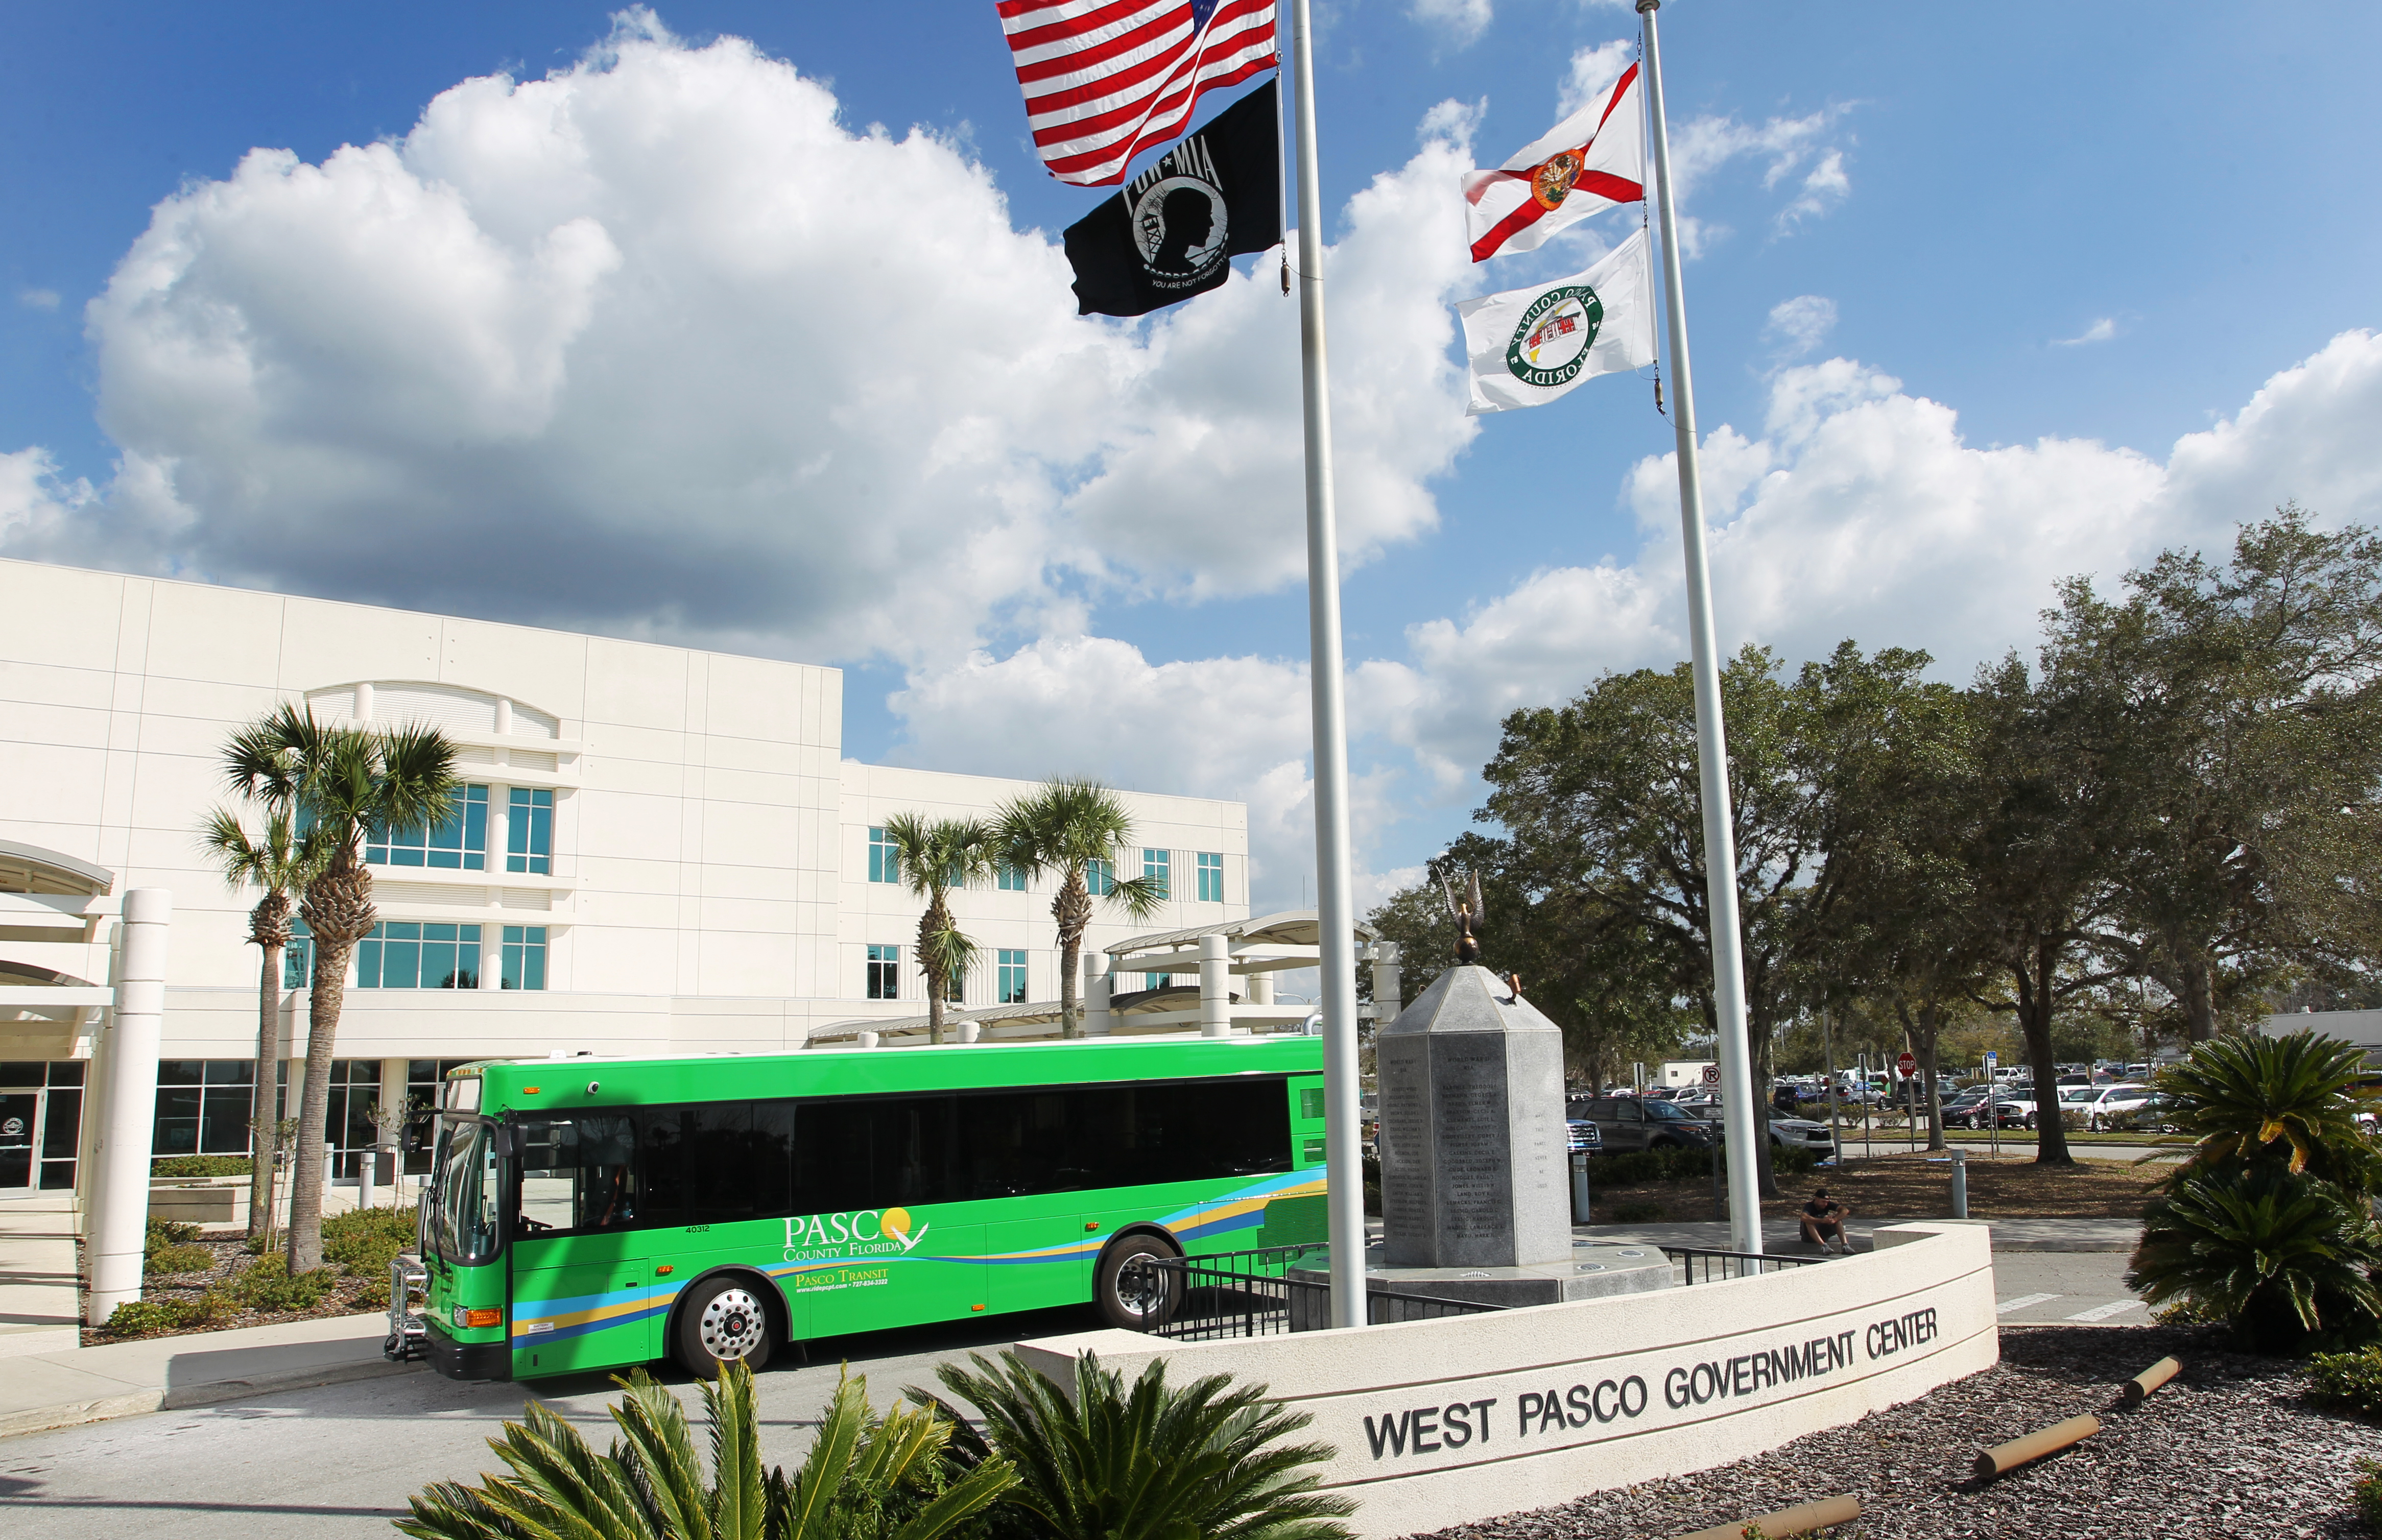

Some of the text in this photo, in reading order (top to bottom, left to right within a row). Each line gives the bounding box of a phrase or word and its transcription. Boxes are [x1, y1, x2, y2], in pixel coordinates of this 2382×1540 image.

[1173, 135, 1223, 192] MIA
[1152, 280, 1166, 288] YOU
[1182, 278, 1197, 287] NOT
[1899, 1060, 1915, 1070] STOP
[685, 1225, 710, 1234] 40312
[783, 1241, 902, 1262] COUNTY FLORIDA
[795, 1268, 889, 1288] PASCO TRANSIT
[796, 1278, 888, 1293] www.ridepcpt.com 727-834-3322
[1364, 1307, 1938, 1460] WEST PASCO GOVERNMENT CENTER
